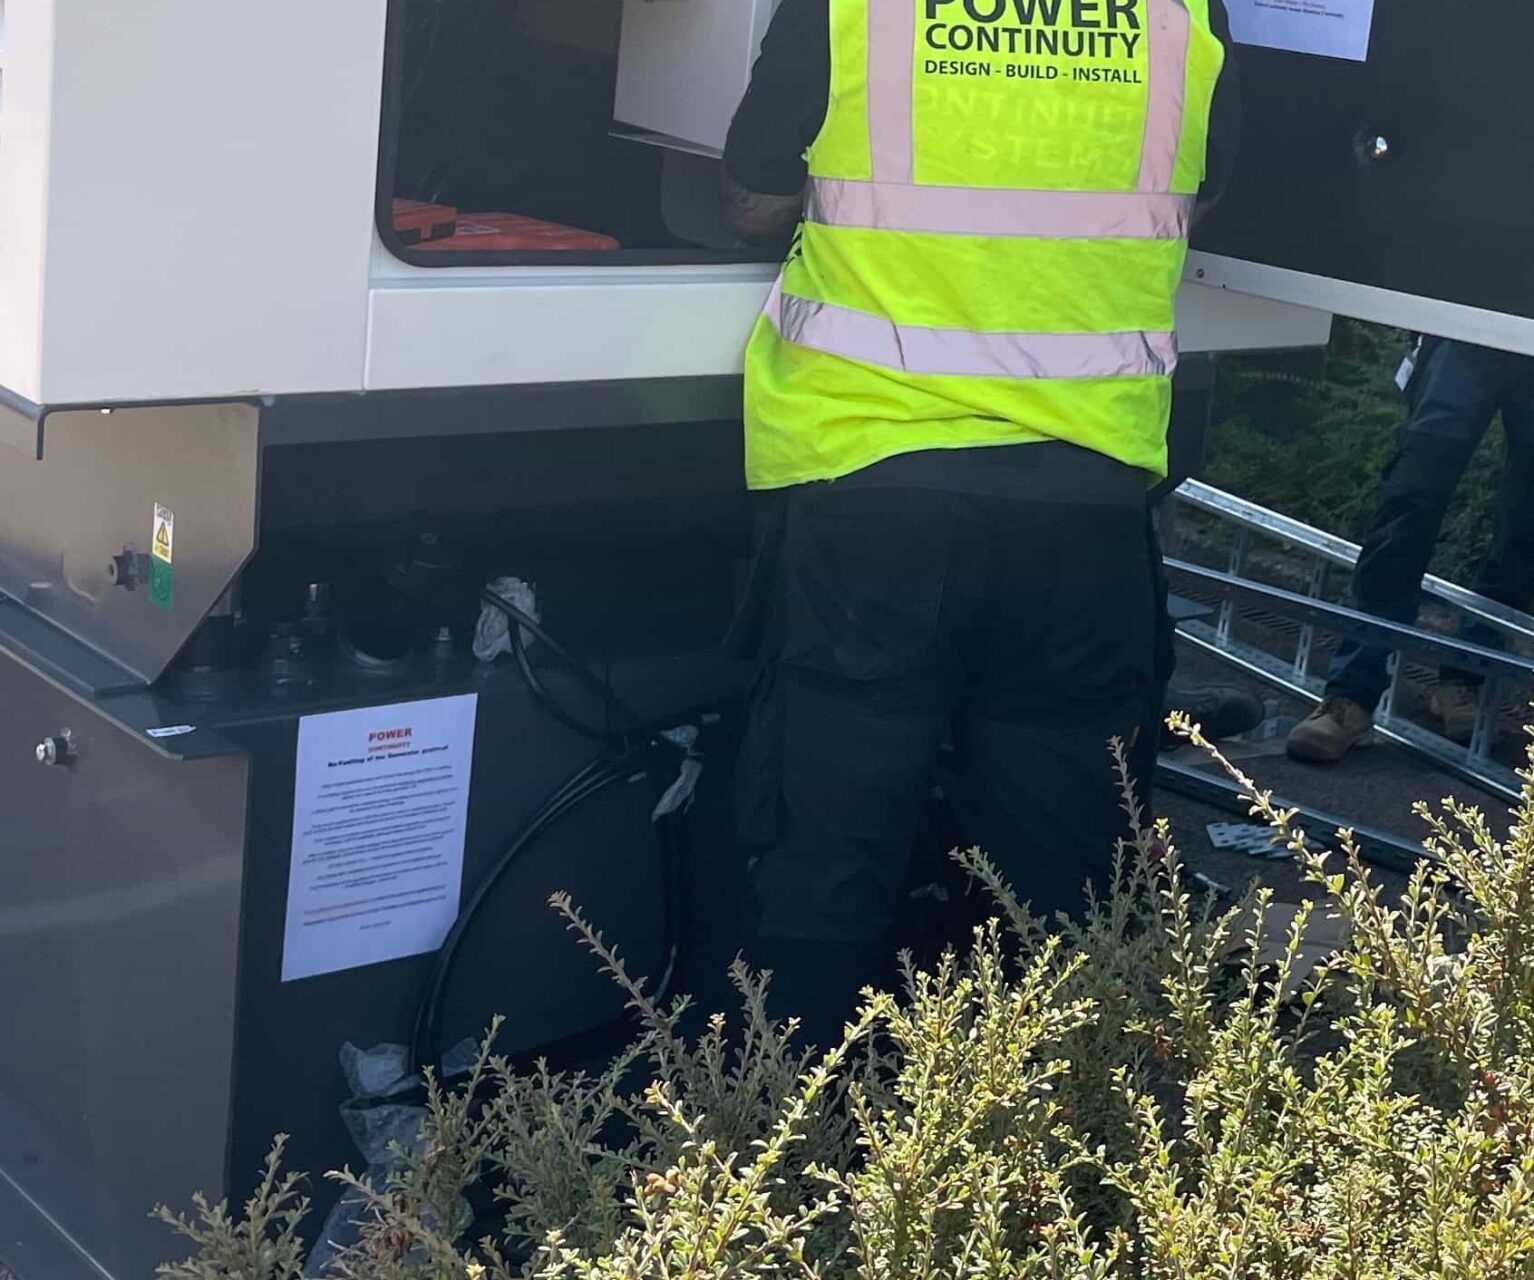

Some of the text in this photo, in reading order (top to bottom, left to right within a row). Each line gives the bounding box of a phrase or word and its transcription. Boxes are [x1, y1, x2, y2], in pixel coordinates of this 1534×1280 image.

[925, 24, 1140, 59] CONTINUITY
[924, 59, 991, 78] DESIGN
[1005, 63, 1058, 80] BUILD
[1072, 67, 1142, 84] INSTALL
[368, 727, 413, 741] POWER
